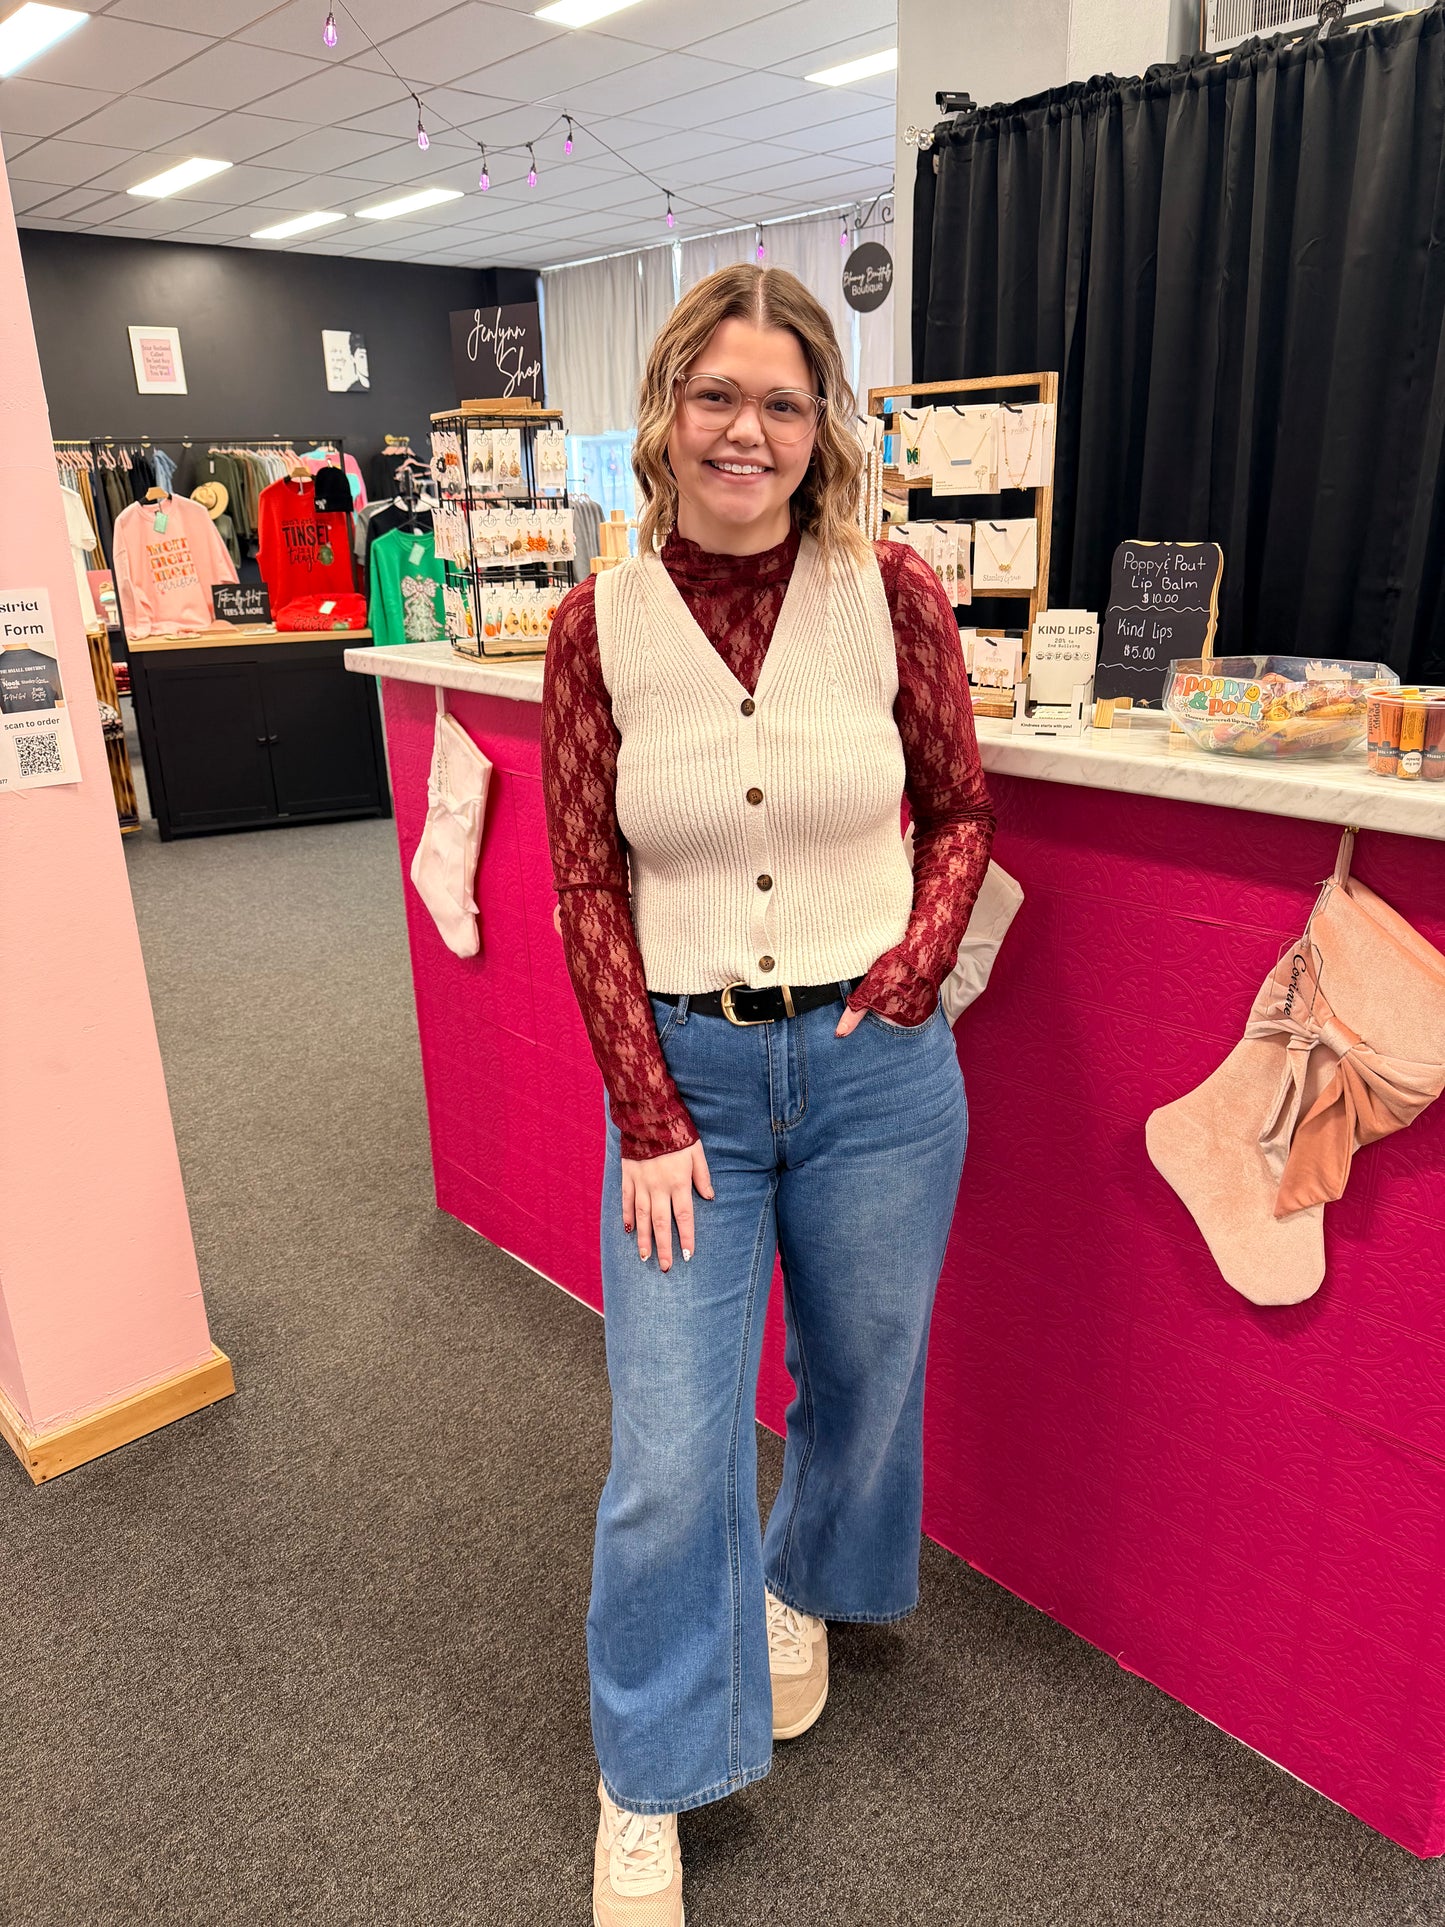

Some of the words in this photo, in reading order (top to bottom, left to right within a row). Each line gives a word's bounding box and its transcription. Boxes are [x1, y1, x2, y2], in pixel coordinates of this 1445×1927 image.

[852, 282, 883, 296] Boutique
[499, 346, 541, 399] Shop
[1123, 551, 1164, 578] Poppy
[1174, 554, 1206, 571] Pout
[1131, 575, 1153, 592] Lip
[1161, 576, 1198, 590] Balm
[246, 607, 264, 615] MORE
[4, 624, 44, 636] Form
[1038, 626, 1065, 635] KIND
[1068, 626, 1096, 635] LIPS.
[1117, 618, 1146, 638] Kind
[1124, 644, 1156, 660] $5.00
[1183, 676, 1253, 702] poppy
[1189, 691, 1208, 710] &
[1208, 698, 1262, 720] pout
[4, 722, 24, 730] scan
[37, 718, 60, 726] order
